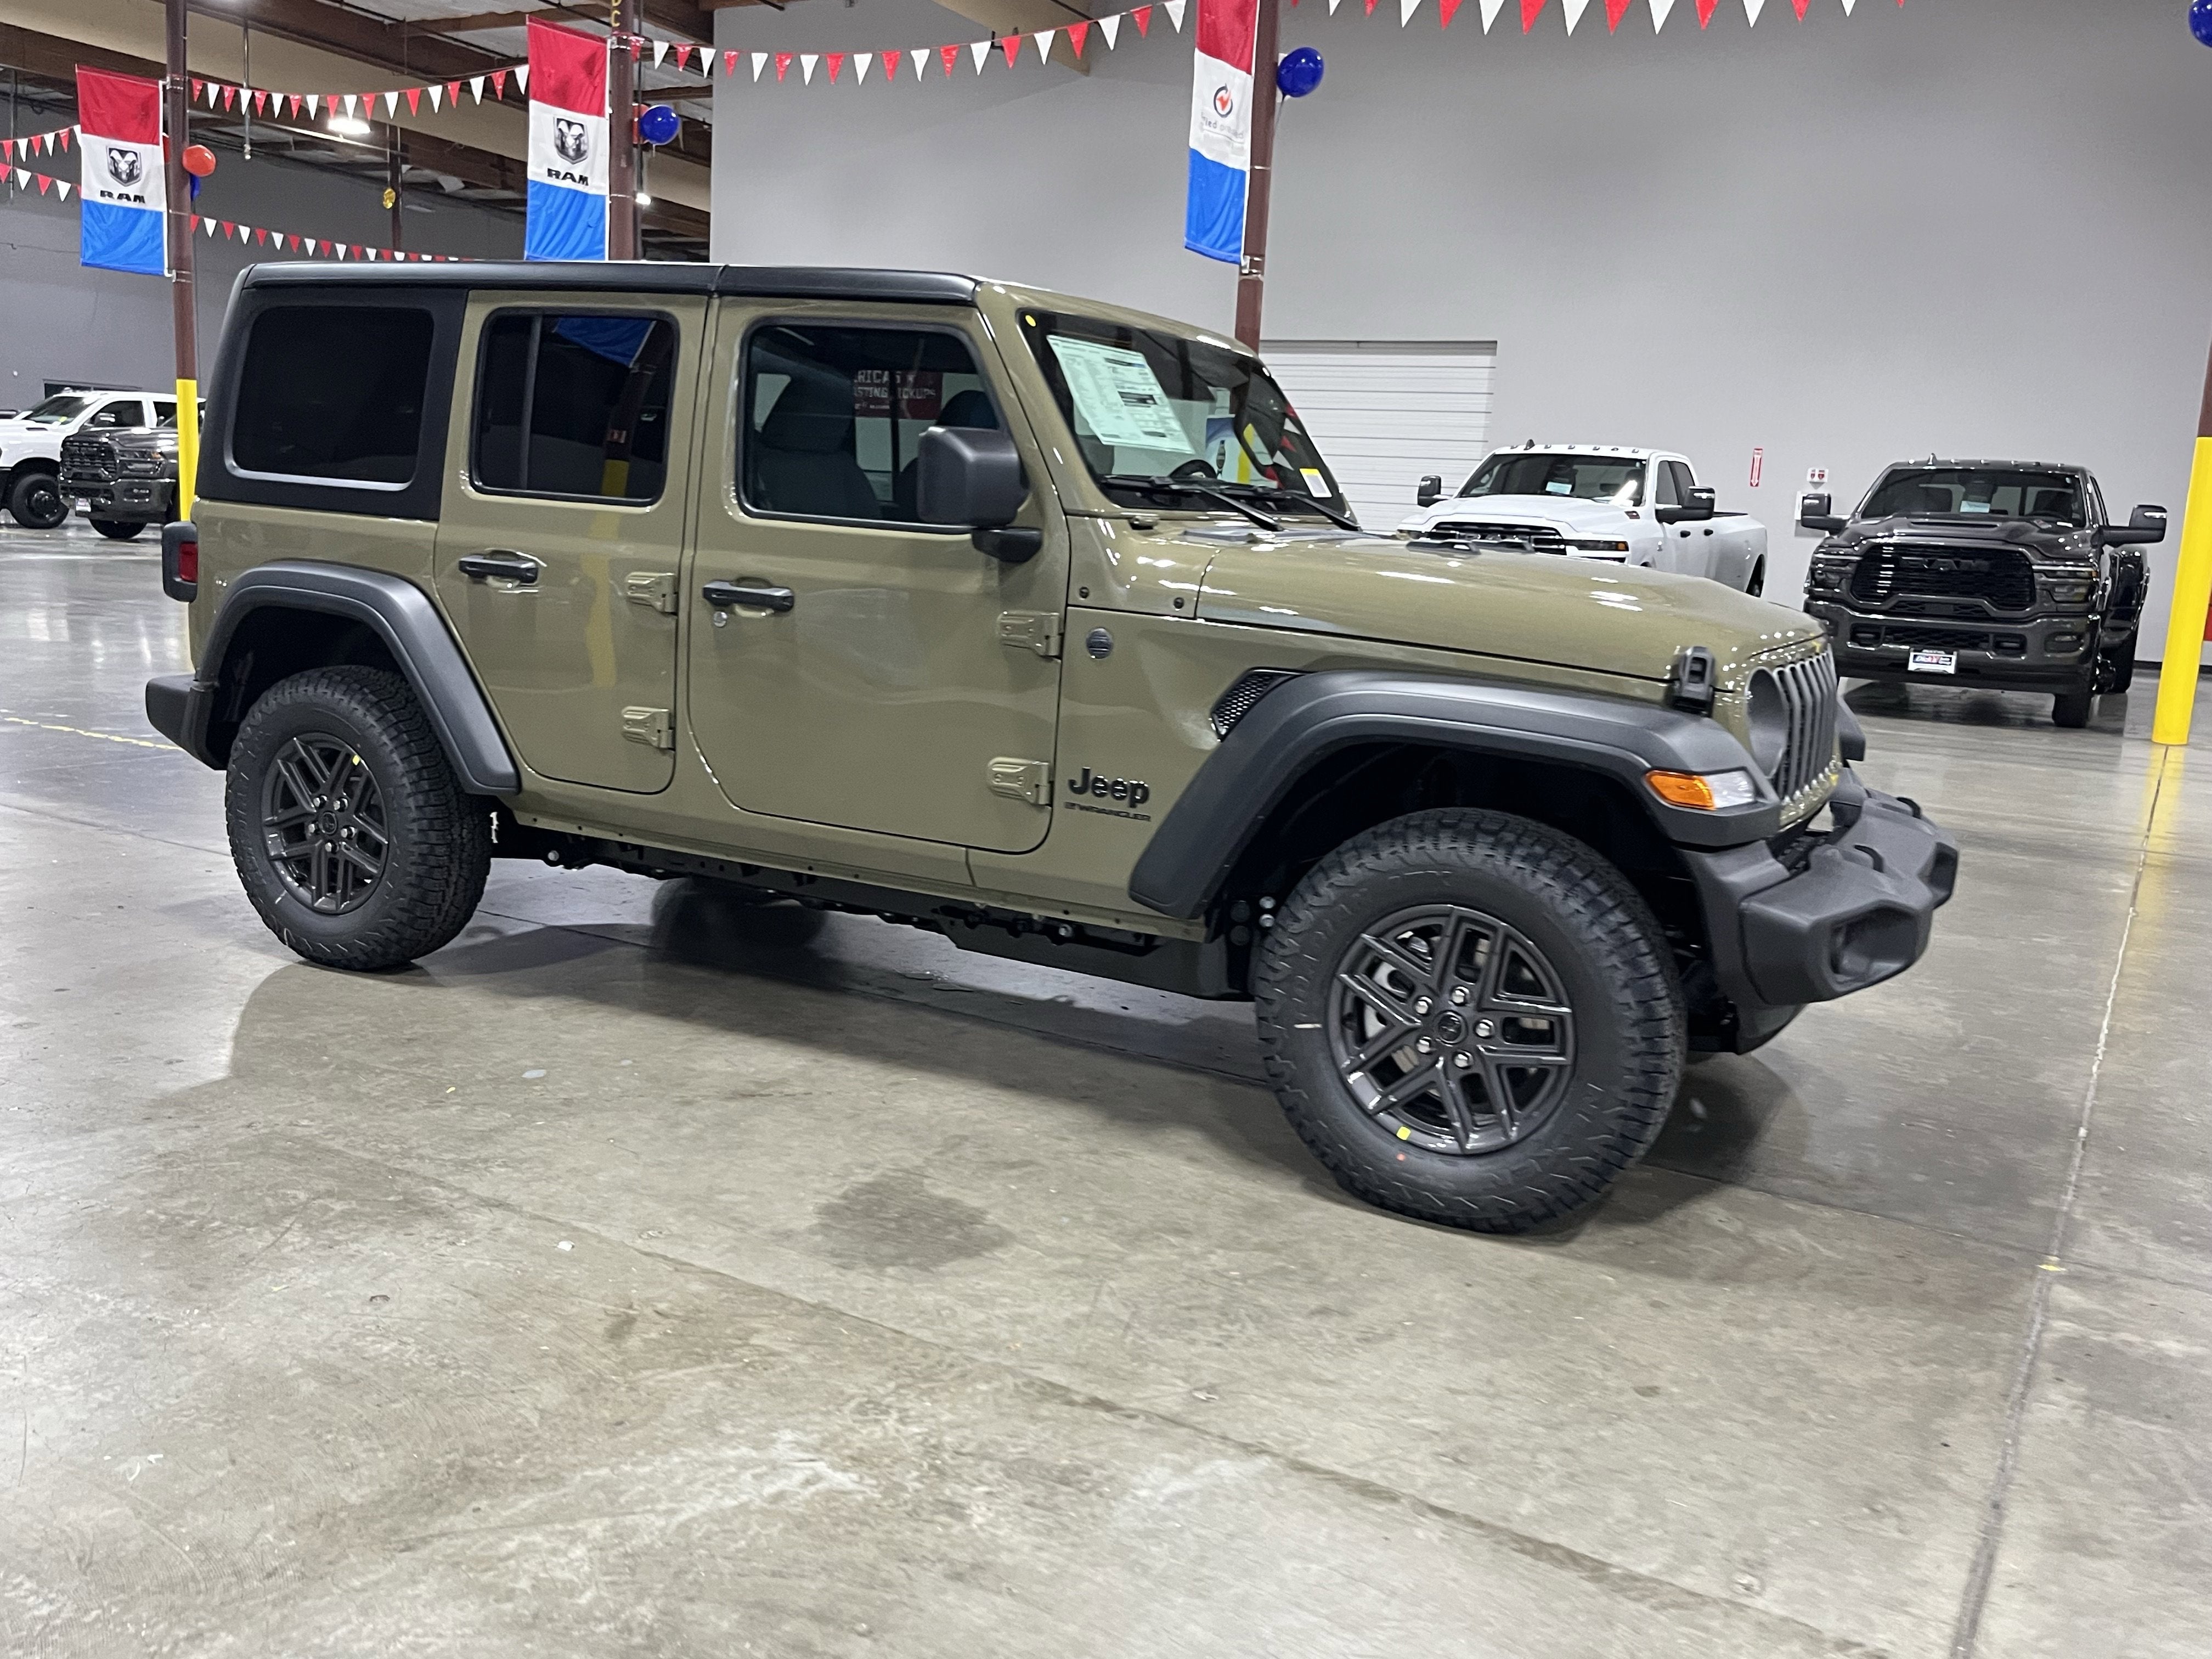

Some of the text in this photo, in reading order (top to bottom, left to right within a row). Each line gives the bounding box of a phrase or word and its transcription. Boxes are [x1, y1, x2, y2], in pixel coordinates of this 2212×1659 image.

[547, 167, 589, 186] RAM
[100, 190, 145, 204] RAM
[1069, 767, 1149, 808] Jeep
